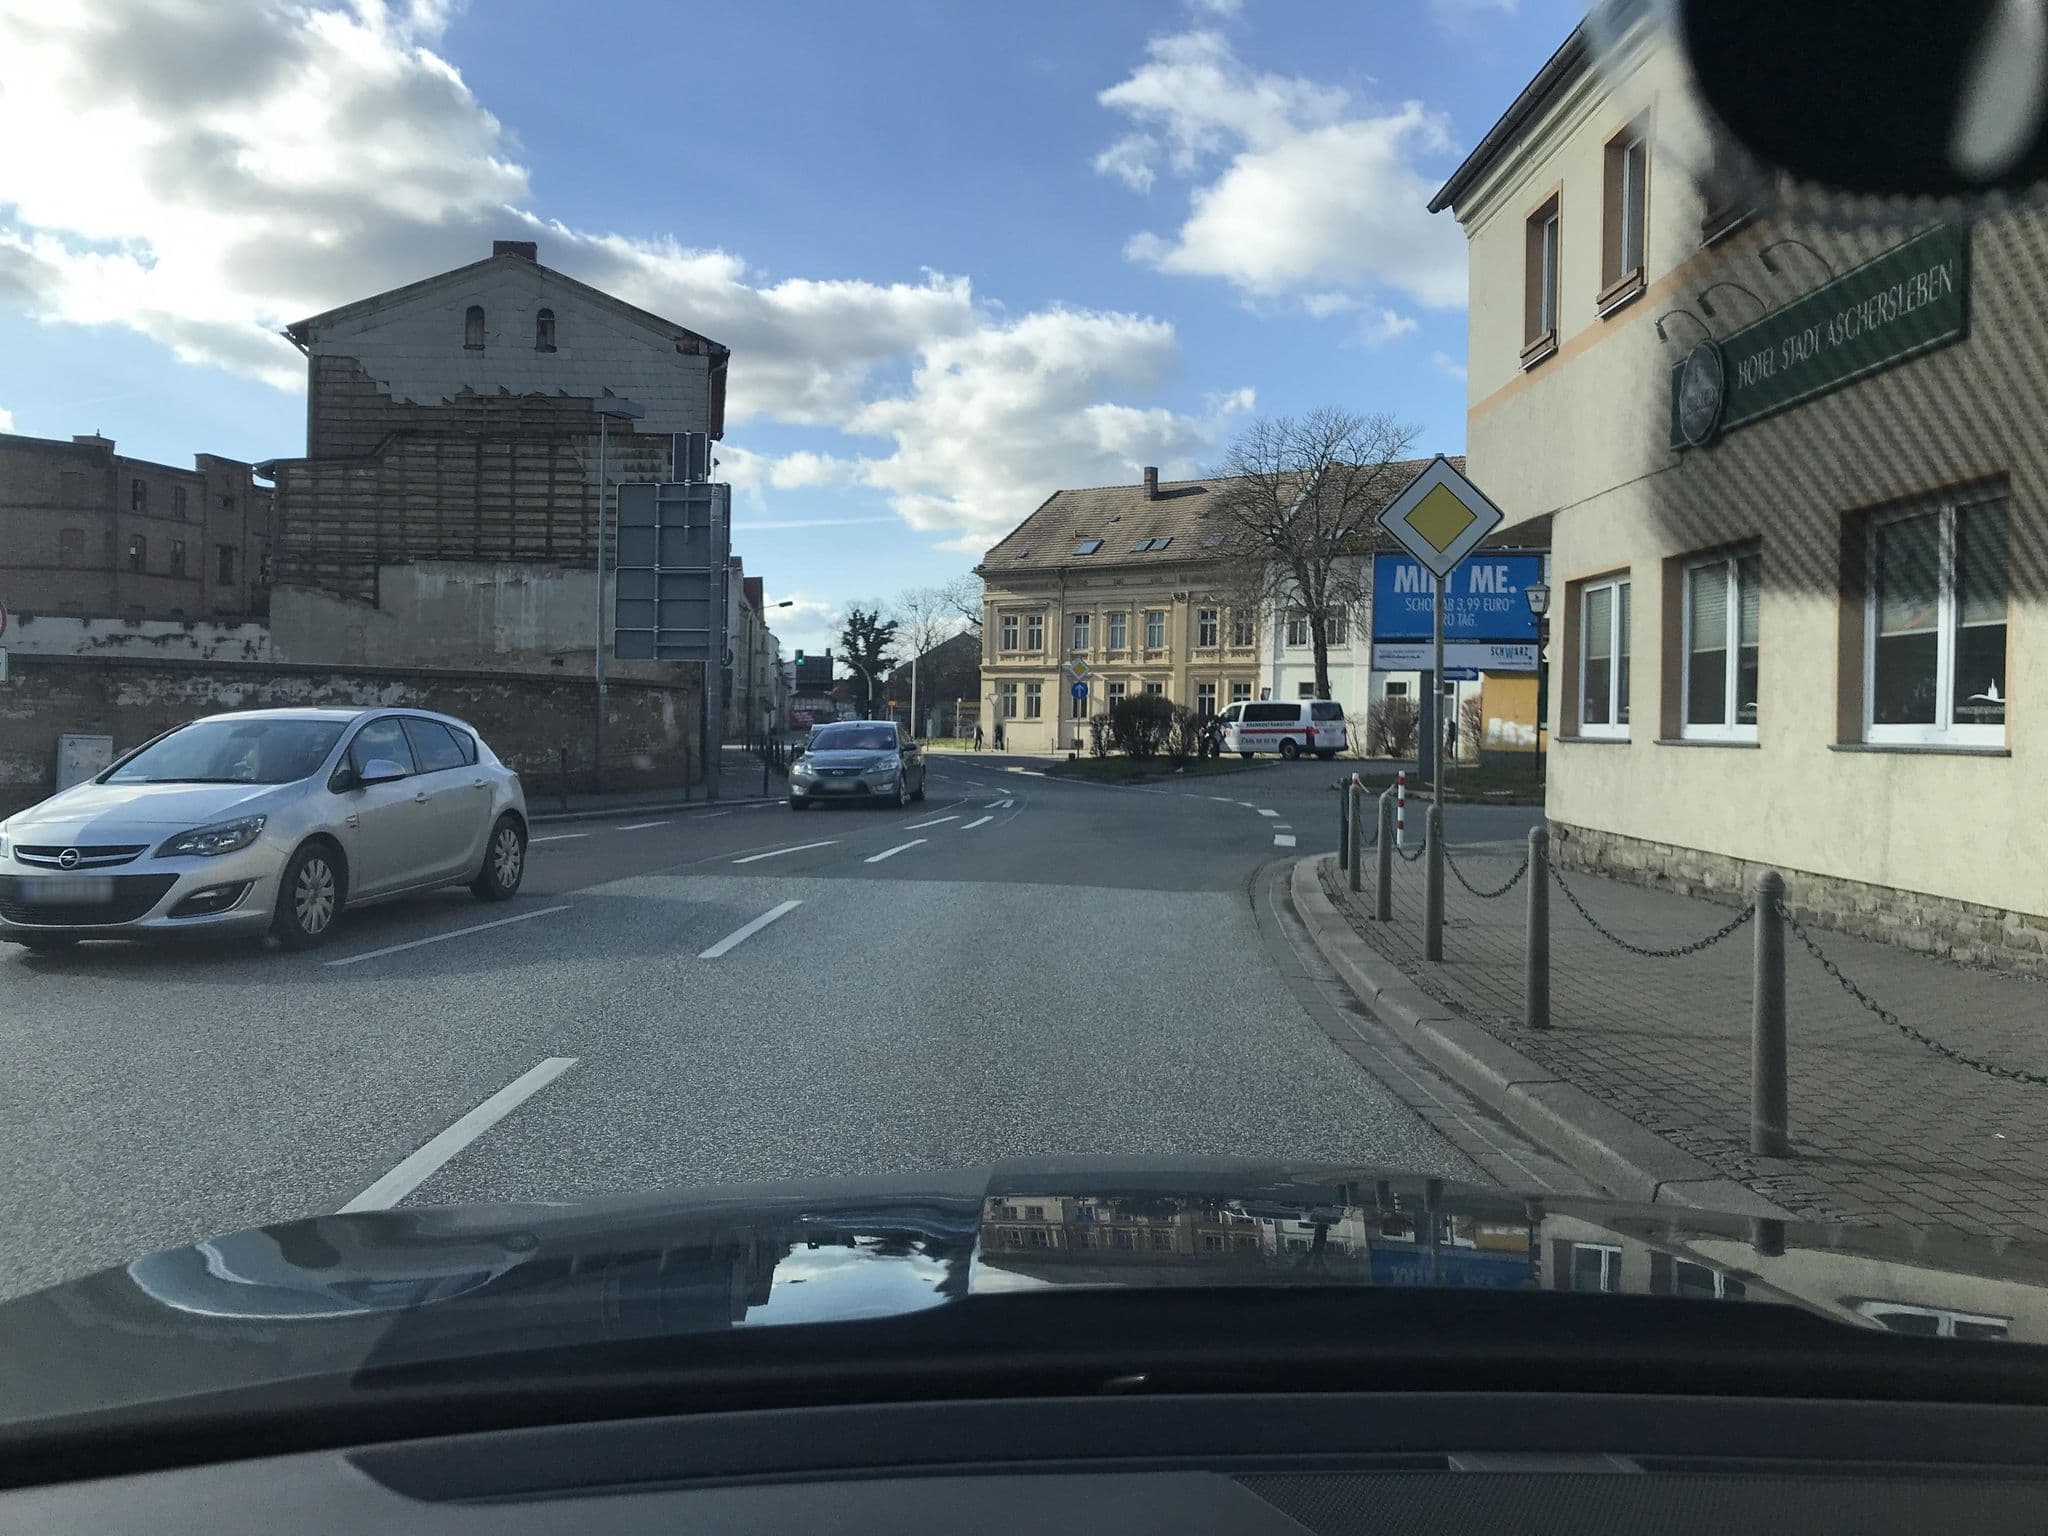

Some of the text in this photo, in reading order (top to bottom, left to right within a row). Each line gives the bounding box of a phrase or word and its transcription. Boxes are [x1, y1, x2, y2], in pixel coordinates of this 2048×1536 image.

[1738, 258, 1953, 389] HOTEL STADT ASCHERSLEBEN
[1469, 564, 1518, 594] ME.
[1405, 597, 1435, 612] SCHO
